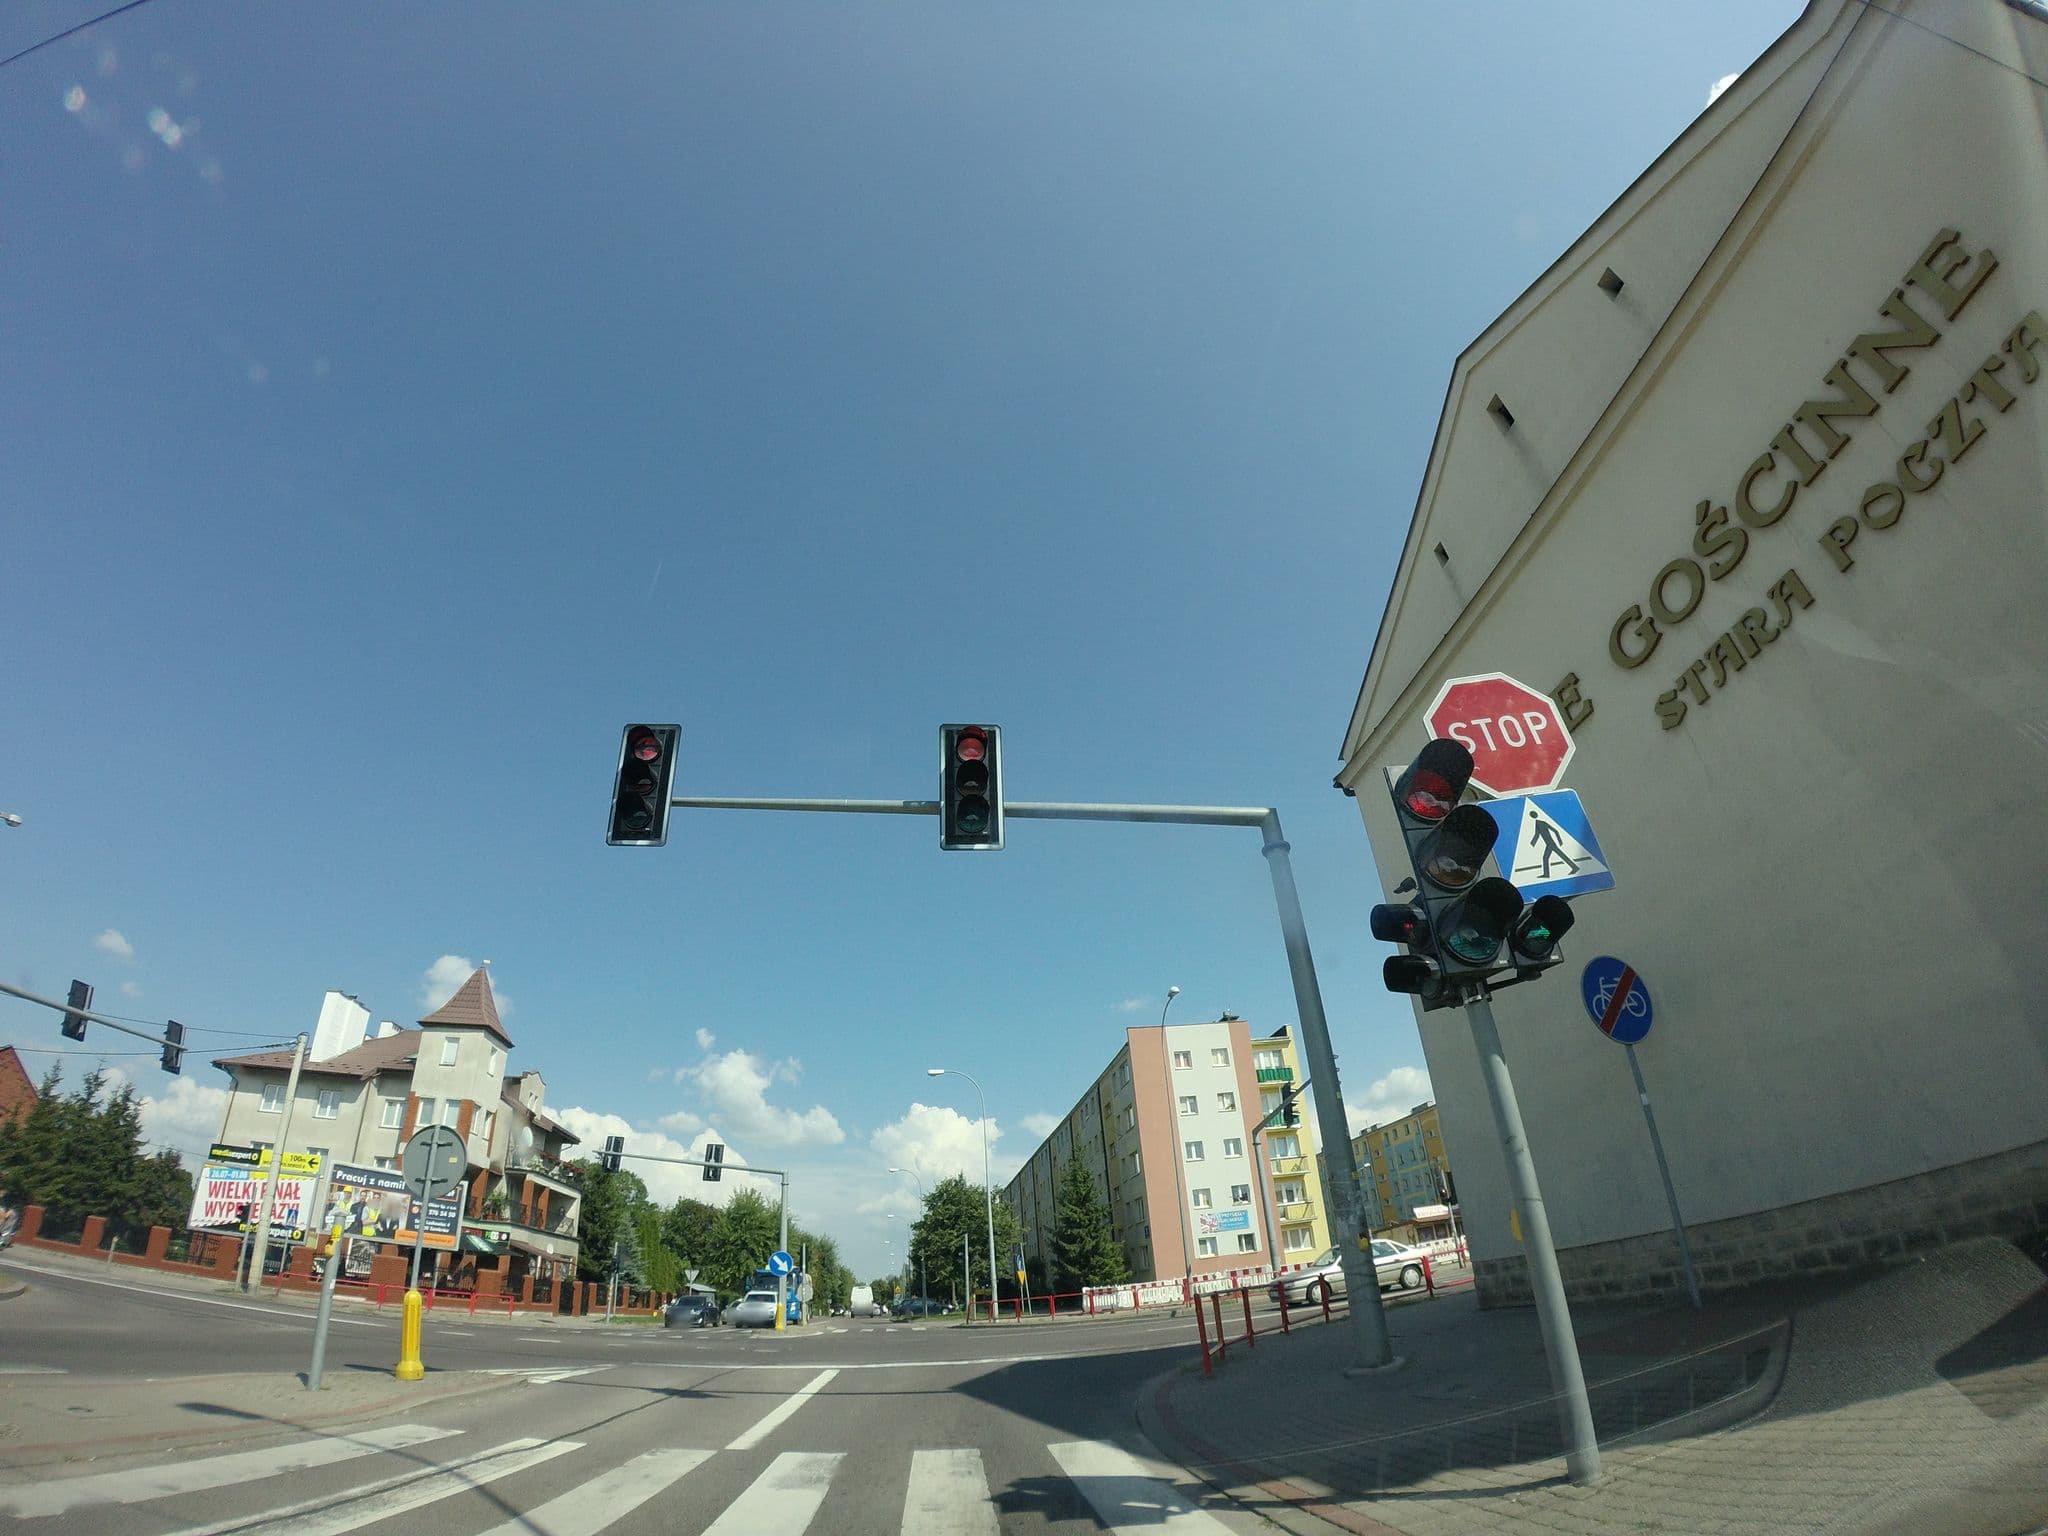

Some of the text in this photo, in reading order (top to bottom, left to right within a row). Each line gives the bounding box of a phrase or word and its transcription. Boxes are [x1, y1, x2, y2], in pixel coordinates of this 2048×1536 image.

[1608, 226, 2001, 669] GOŚCINNE
[1654, 568, 1816, 731] STARA
[1448, 711, 1548, 754] STOP
[260, 1181, 301, 1201] FNAŁ
[336, 1170, 368, 1186] Pracuj
[377, 1179, 406, 1190] nami!
